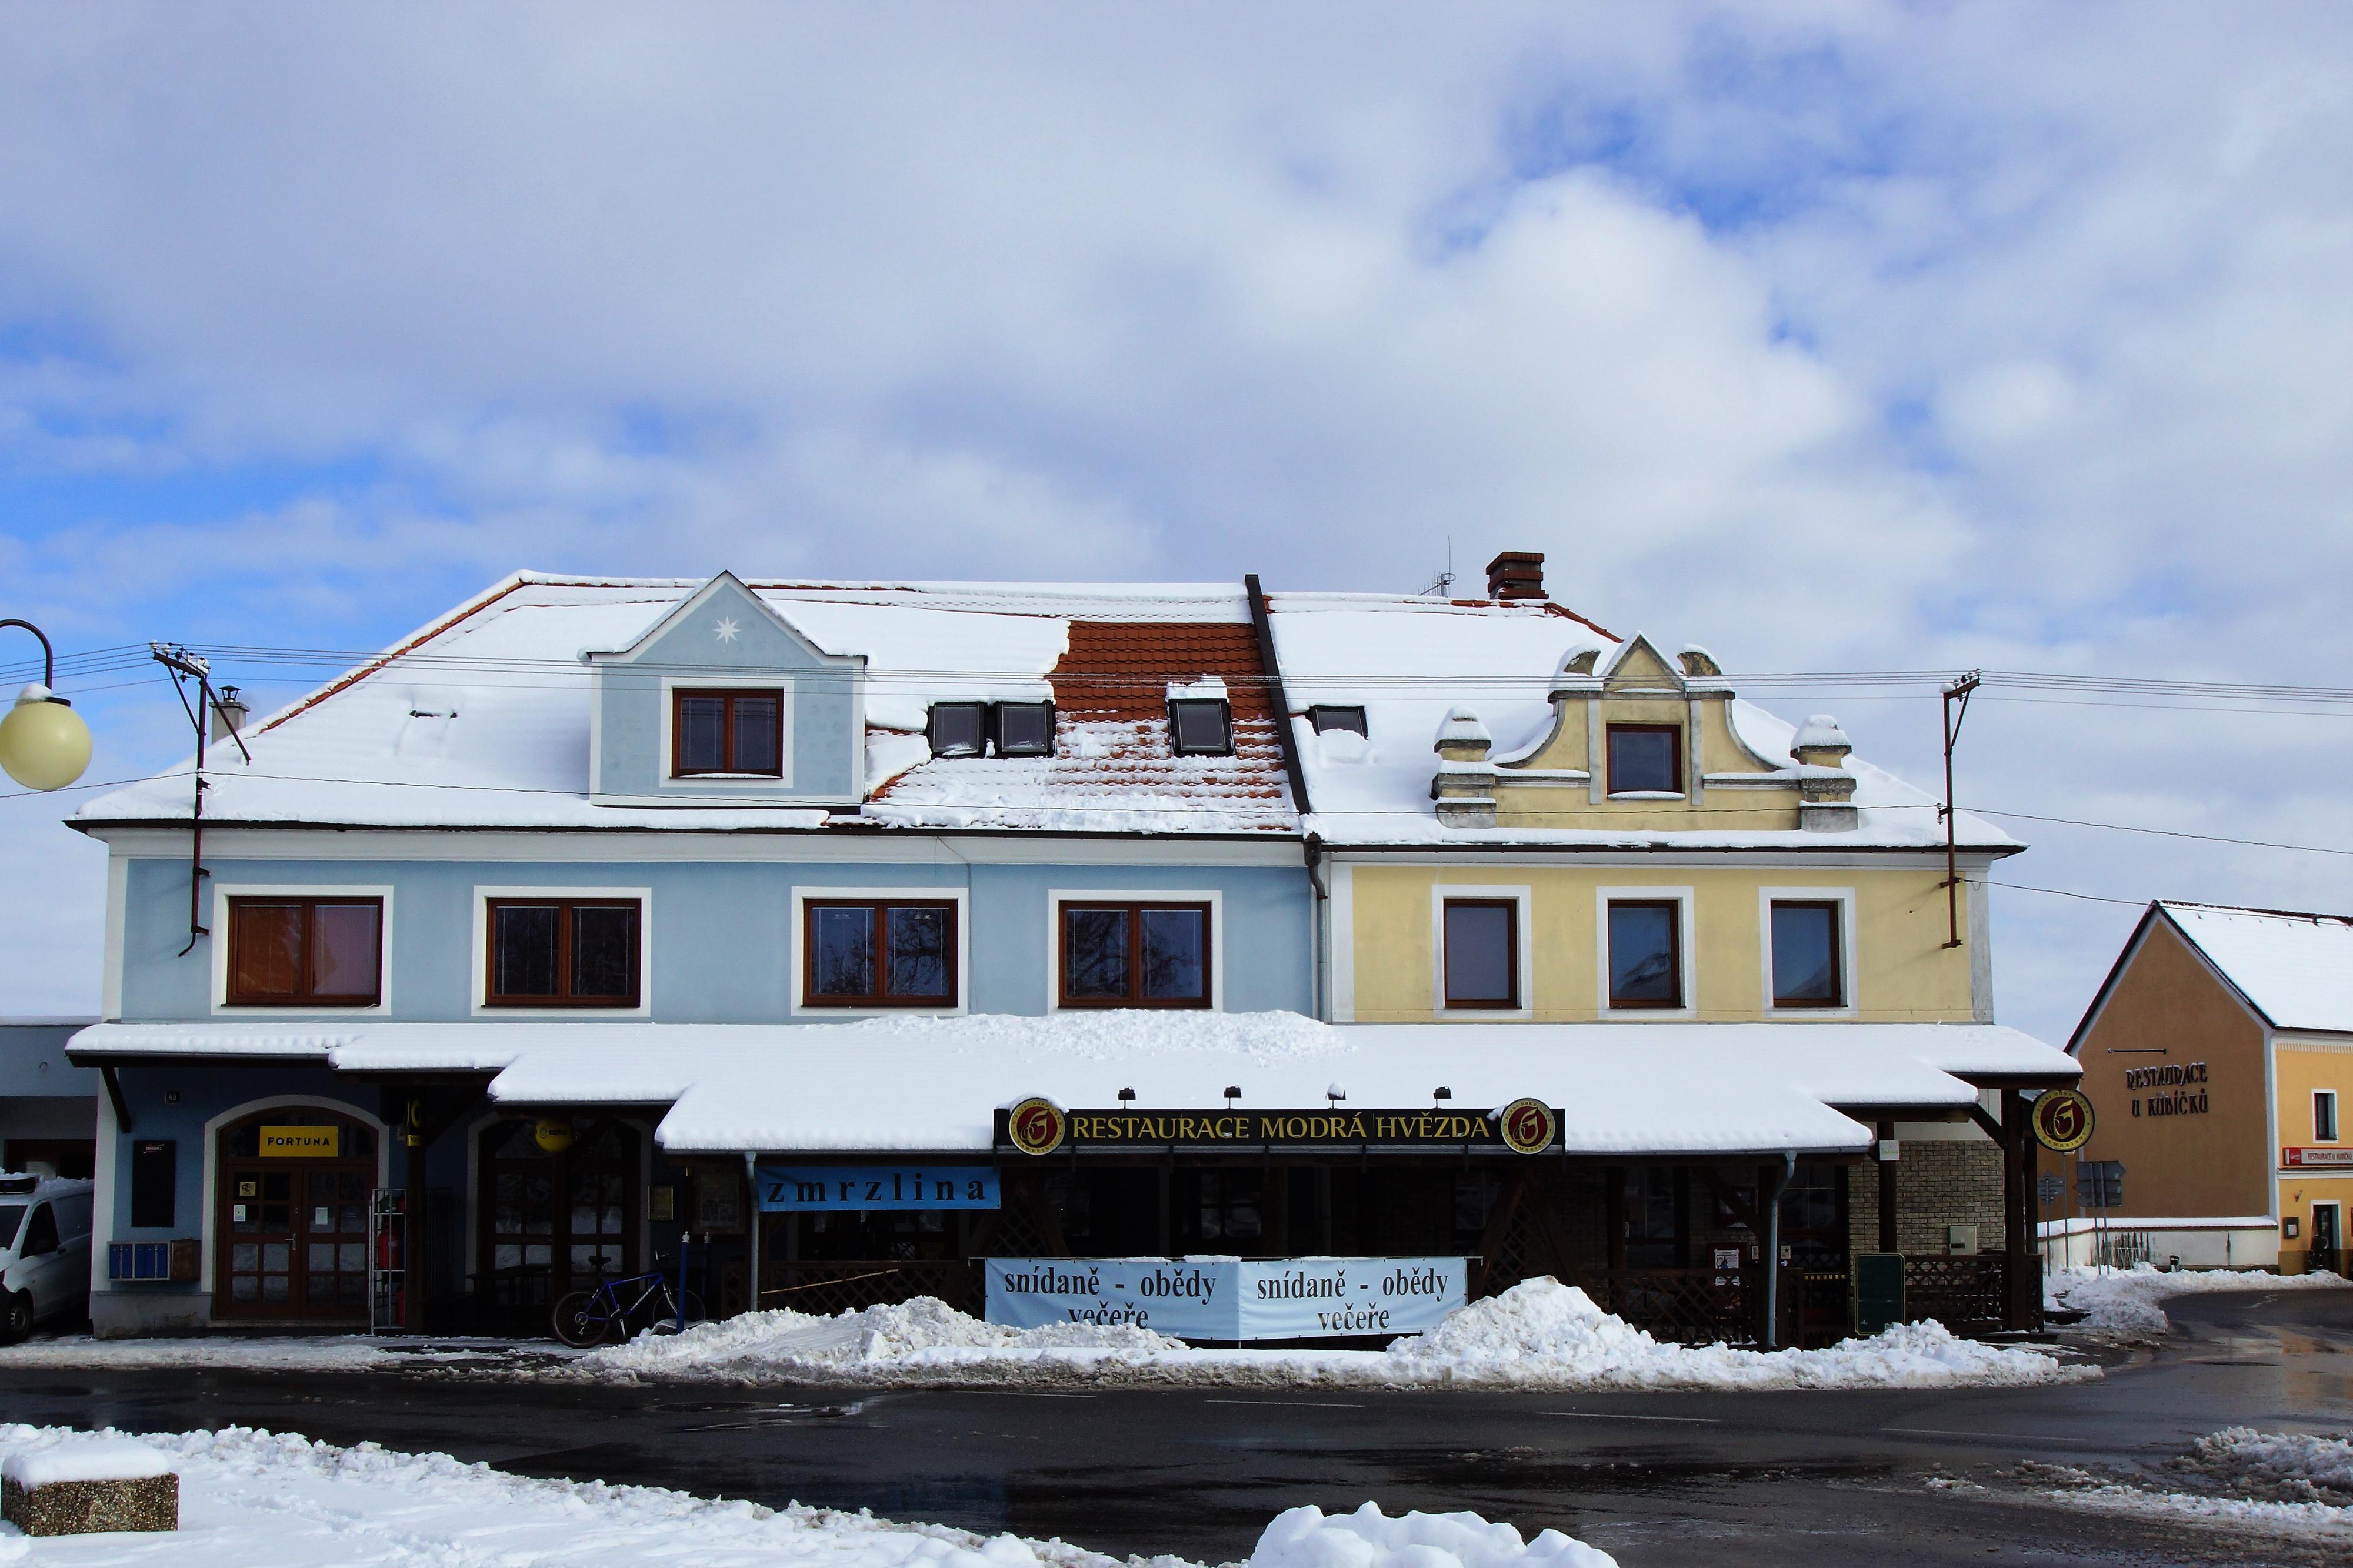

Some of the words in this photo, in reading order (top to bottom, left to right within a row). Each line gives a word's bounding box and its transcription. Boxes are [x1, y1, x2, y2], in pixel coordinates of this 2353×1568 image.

[2125, 1062, 2208, 1090] RESTAURACE
[2132, 1099, 2140, 1117] U
[1072, 1117, 1249, 1139] RESTAURACE
[1261, 1112, 1367, 1139] MODRÁ
[1375, 1111, 1490, 1139] HVĚZDA
[268, 1137, 330, 1146] FORTUNA
[767, 1173, 985, 1203] zmrzlina
[1005, 1266, 1100, 1295] snídaně
[1140, 1269, 1217, 1305] obědy
[1257, 1269, 1347, 1300] snídaně
[1382, 1267, 1449, 1302] obědy
[1068, 1300, 1149, 1329] večeře
[1317, 1302, 1390, 1332] večeře
